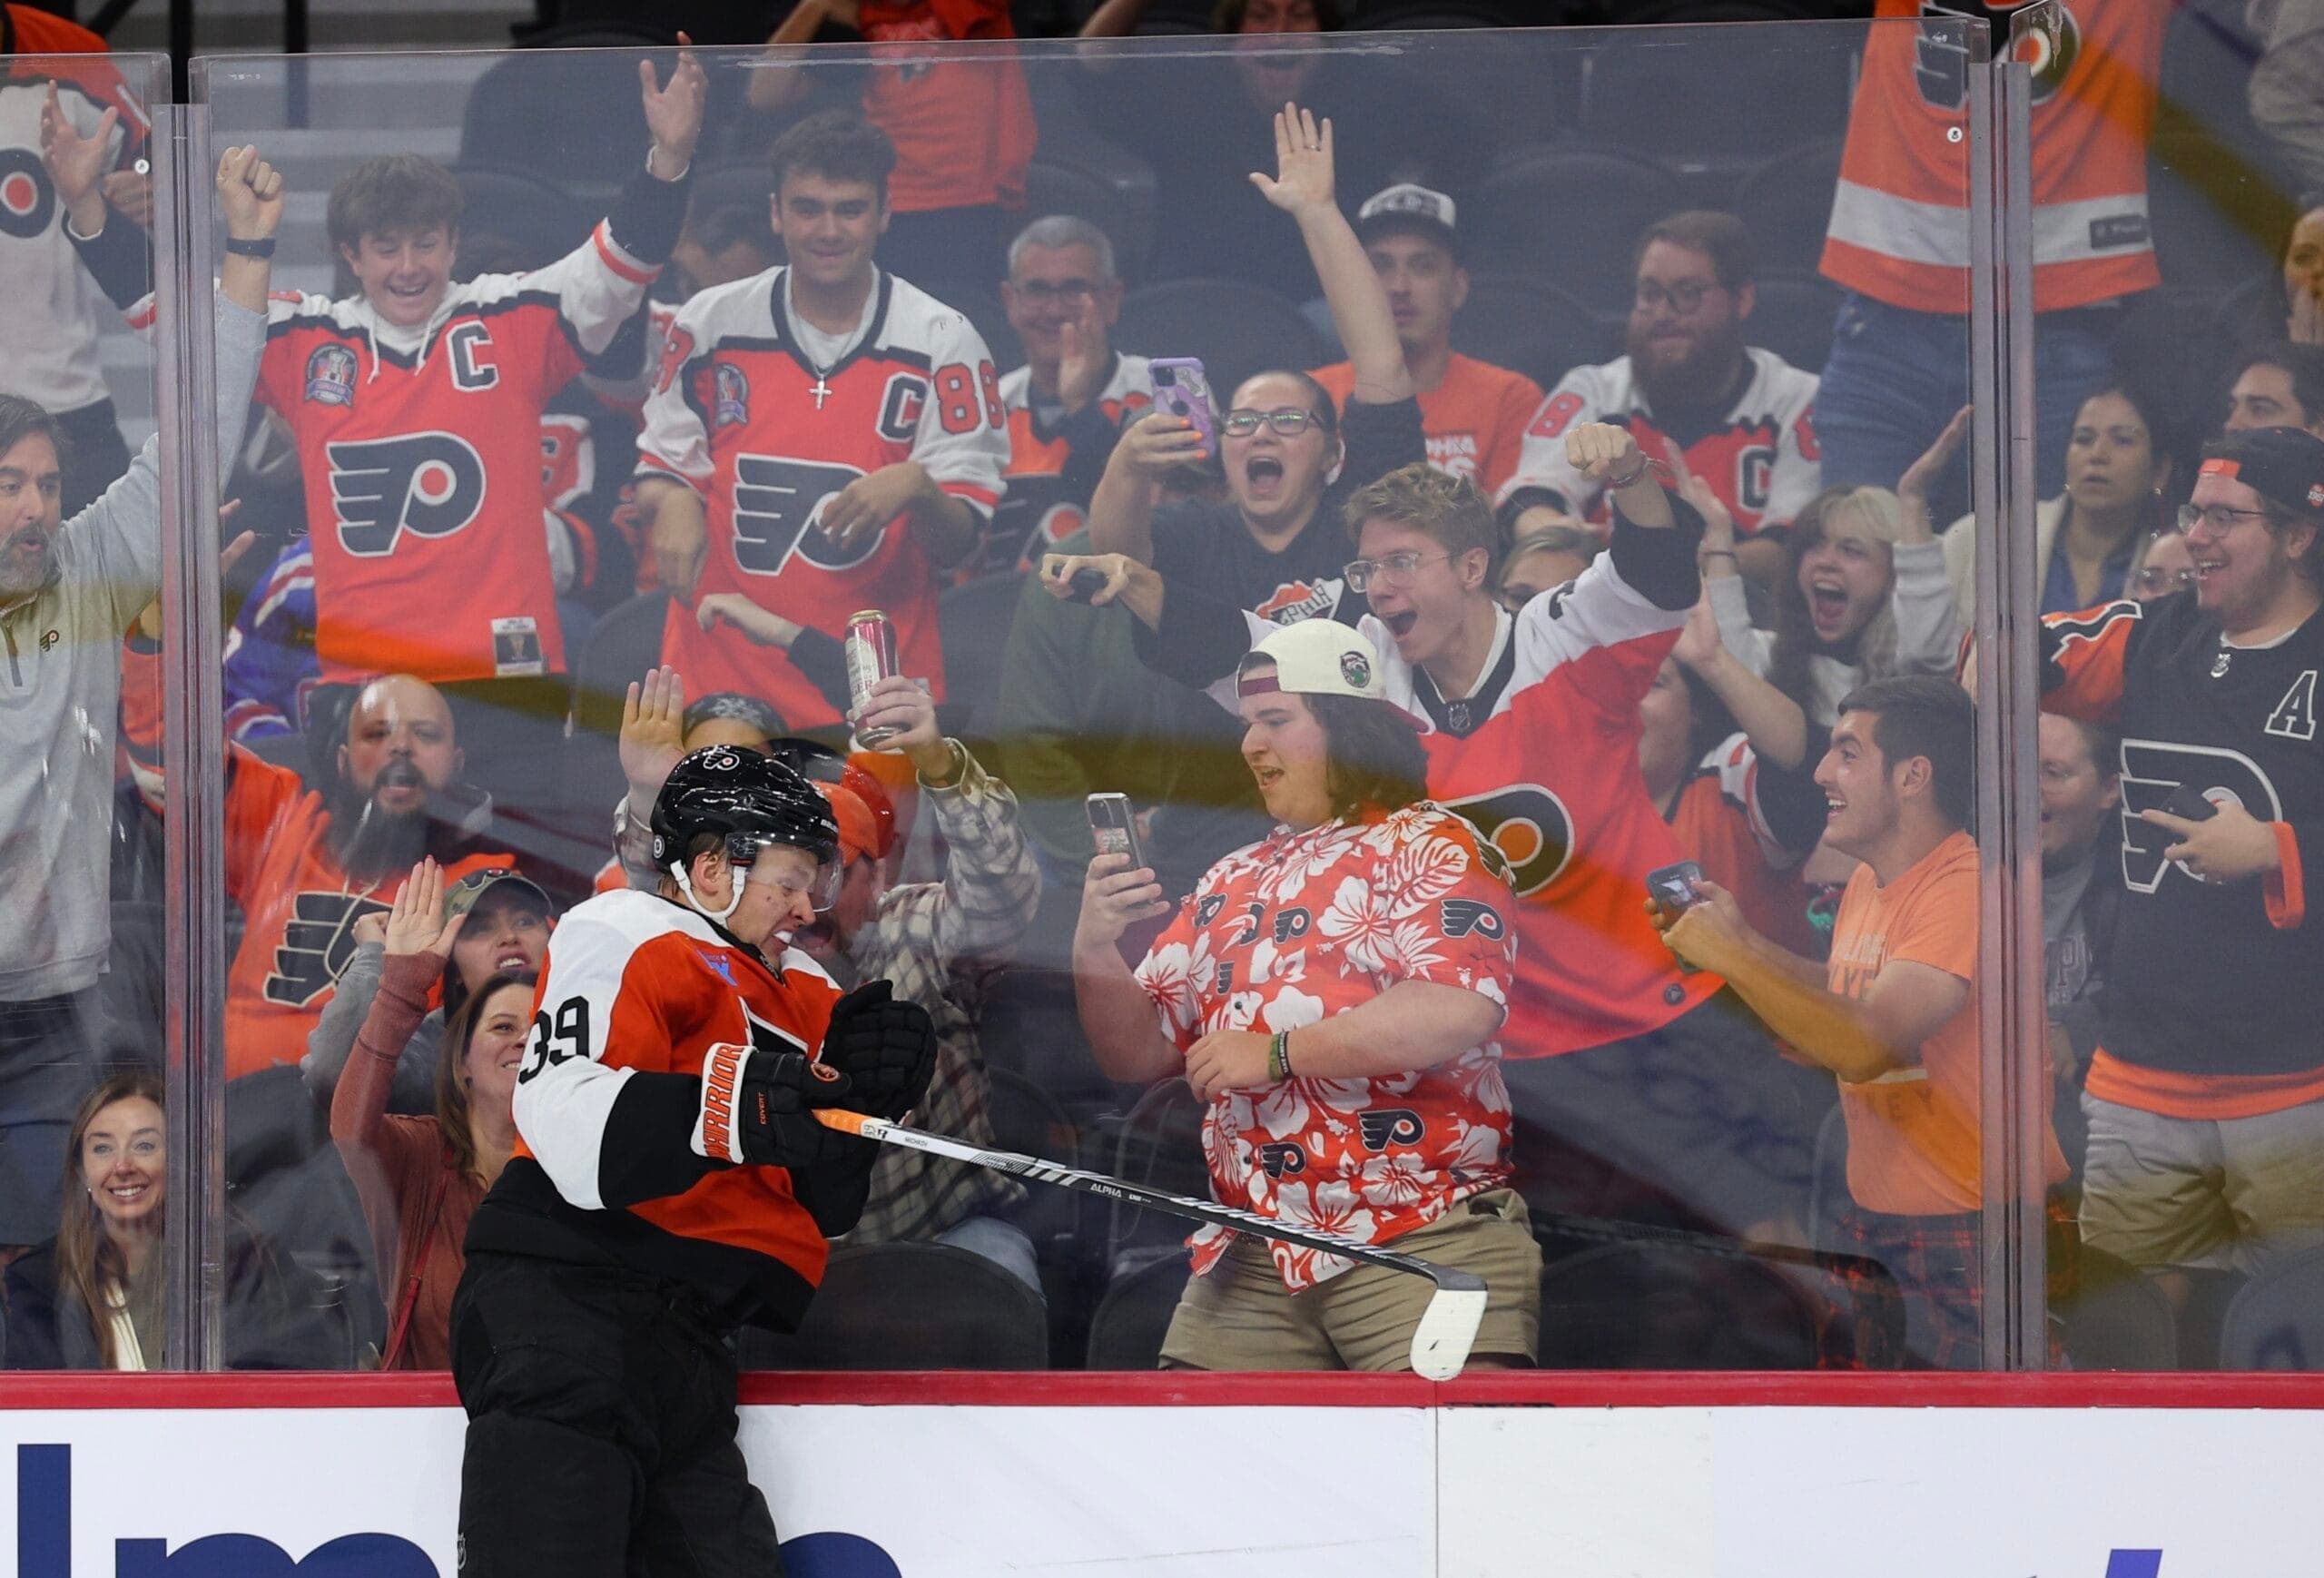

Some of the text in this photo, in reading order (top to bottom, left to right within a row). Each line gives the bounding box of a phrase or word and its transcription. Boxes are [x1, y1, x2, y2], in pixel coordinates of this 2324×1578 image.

[446, 320, 499, 392] C
[875, 371, 931, 443] C
[933, 360, 1009, 436] 88
[1736, 444, 1777, 515] C
[2264, 670, 2318, 741] A
[518, 995, 590, 1085] 39
[1089, 1183, 1122, 1198] ALPHA
